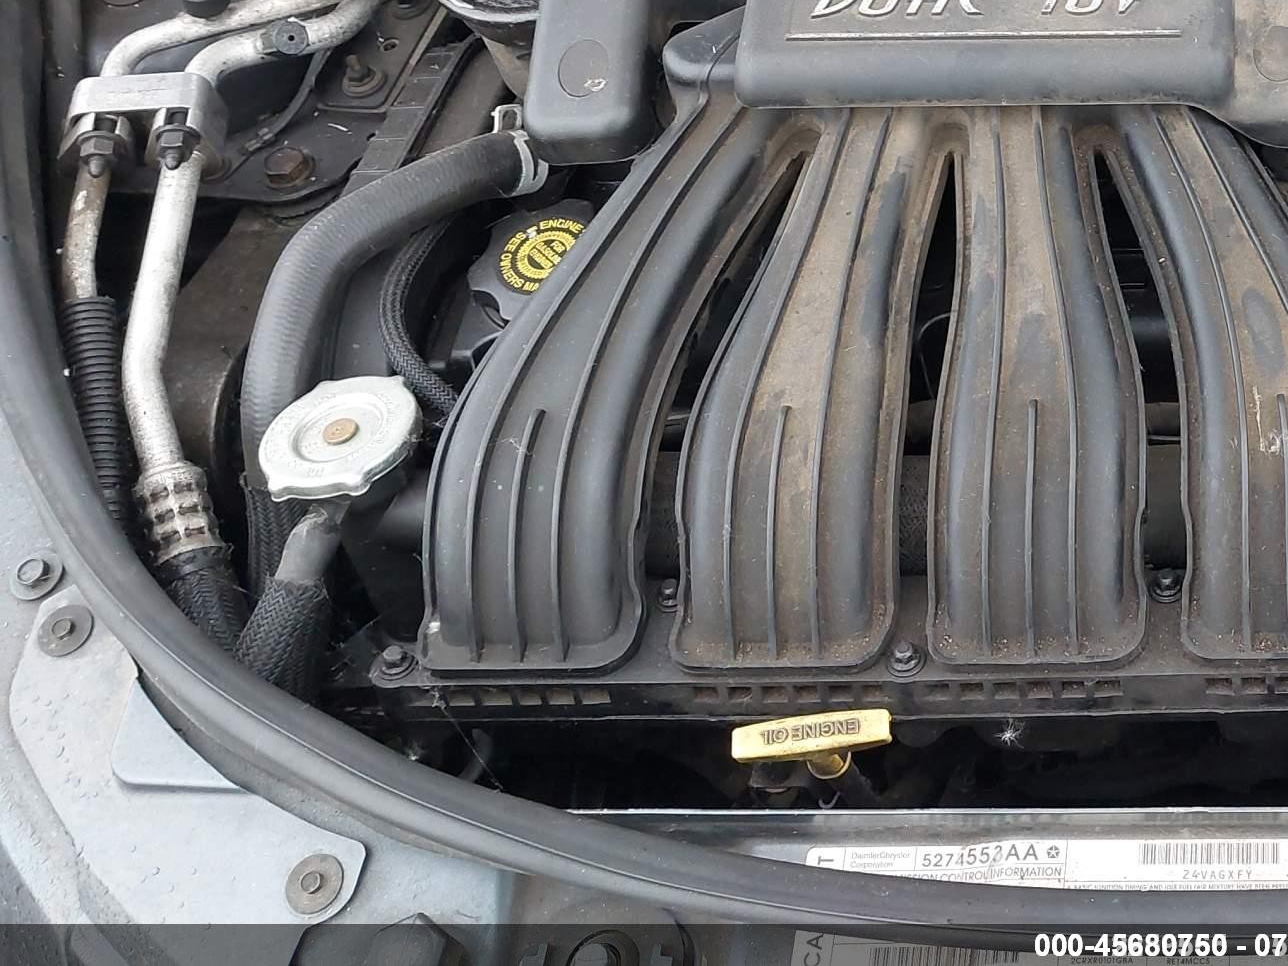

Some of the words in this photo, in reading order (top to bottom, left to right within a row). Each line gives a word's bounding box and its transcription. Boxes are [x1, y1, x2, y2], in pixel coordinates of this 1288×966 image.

[539, 218, 585, 233] ENGINE
[504, 231, 526, 252] SEE
[500, 253, 525, 289] OWNERS
[760, 727, 789, 746] OIL
[791, 717, 861, 741] ENGINE
[990, 866, 1063, 878] INFORMATION
